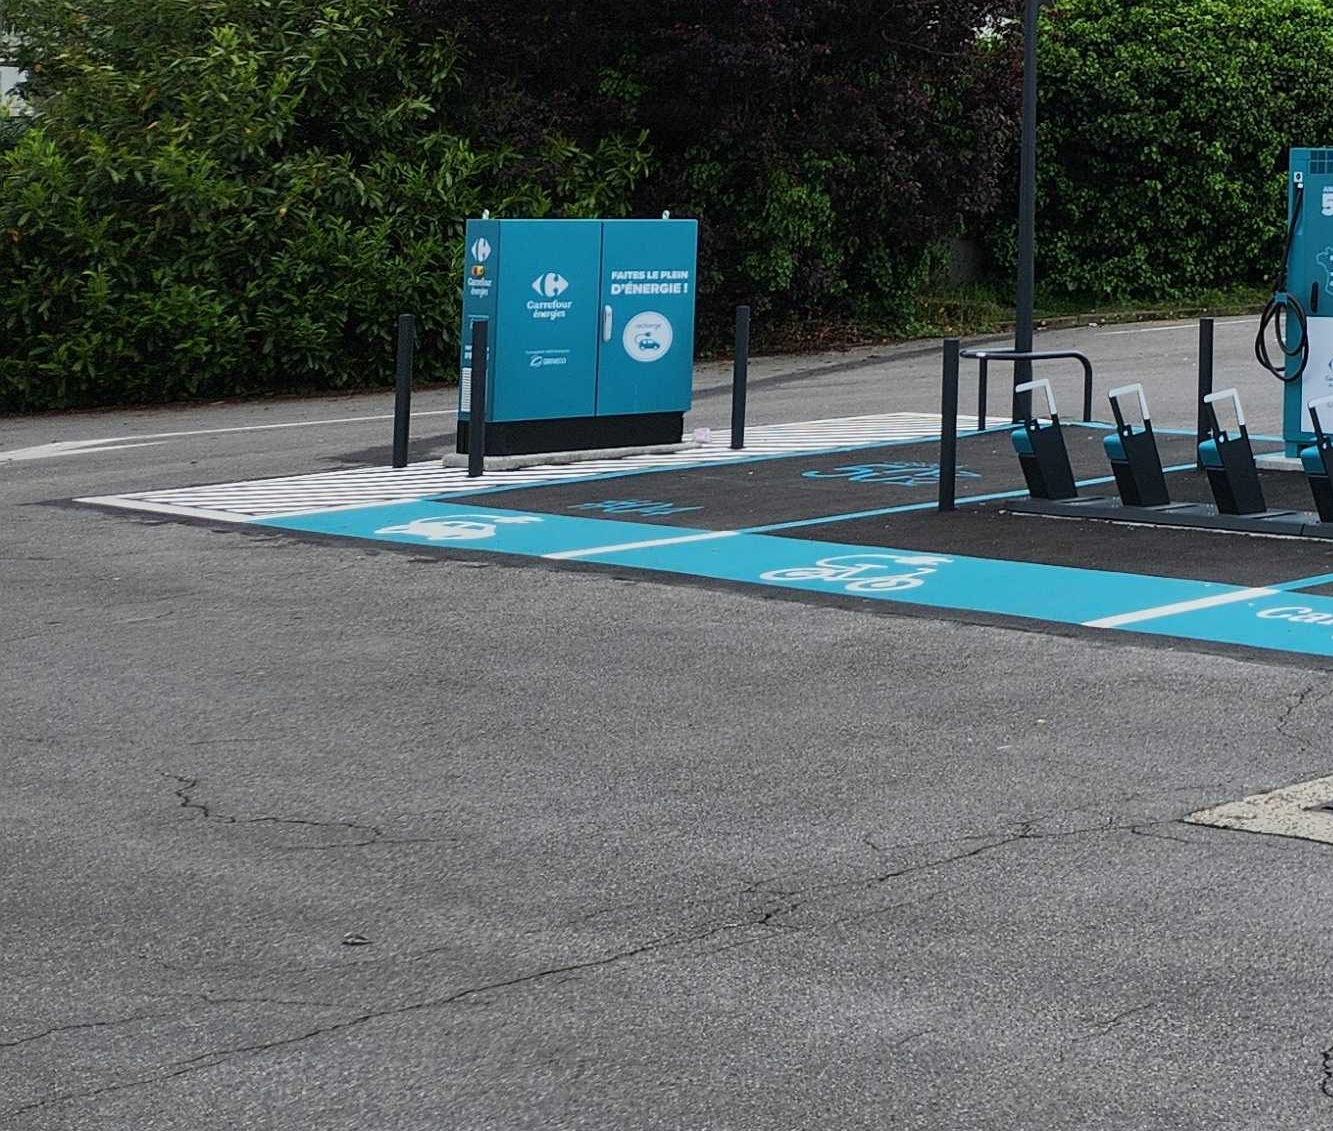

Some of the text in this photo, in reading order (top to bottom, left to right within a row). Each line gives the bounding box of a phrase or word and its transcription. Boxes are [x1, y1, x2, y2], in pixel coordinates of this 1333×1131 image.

[611, 271, 689, 280] FAITES LE PLEIN
